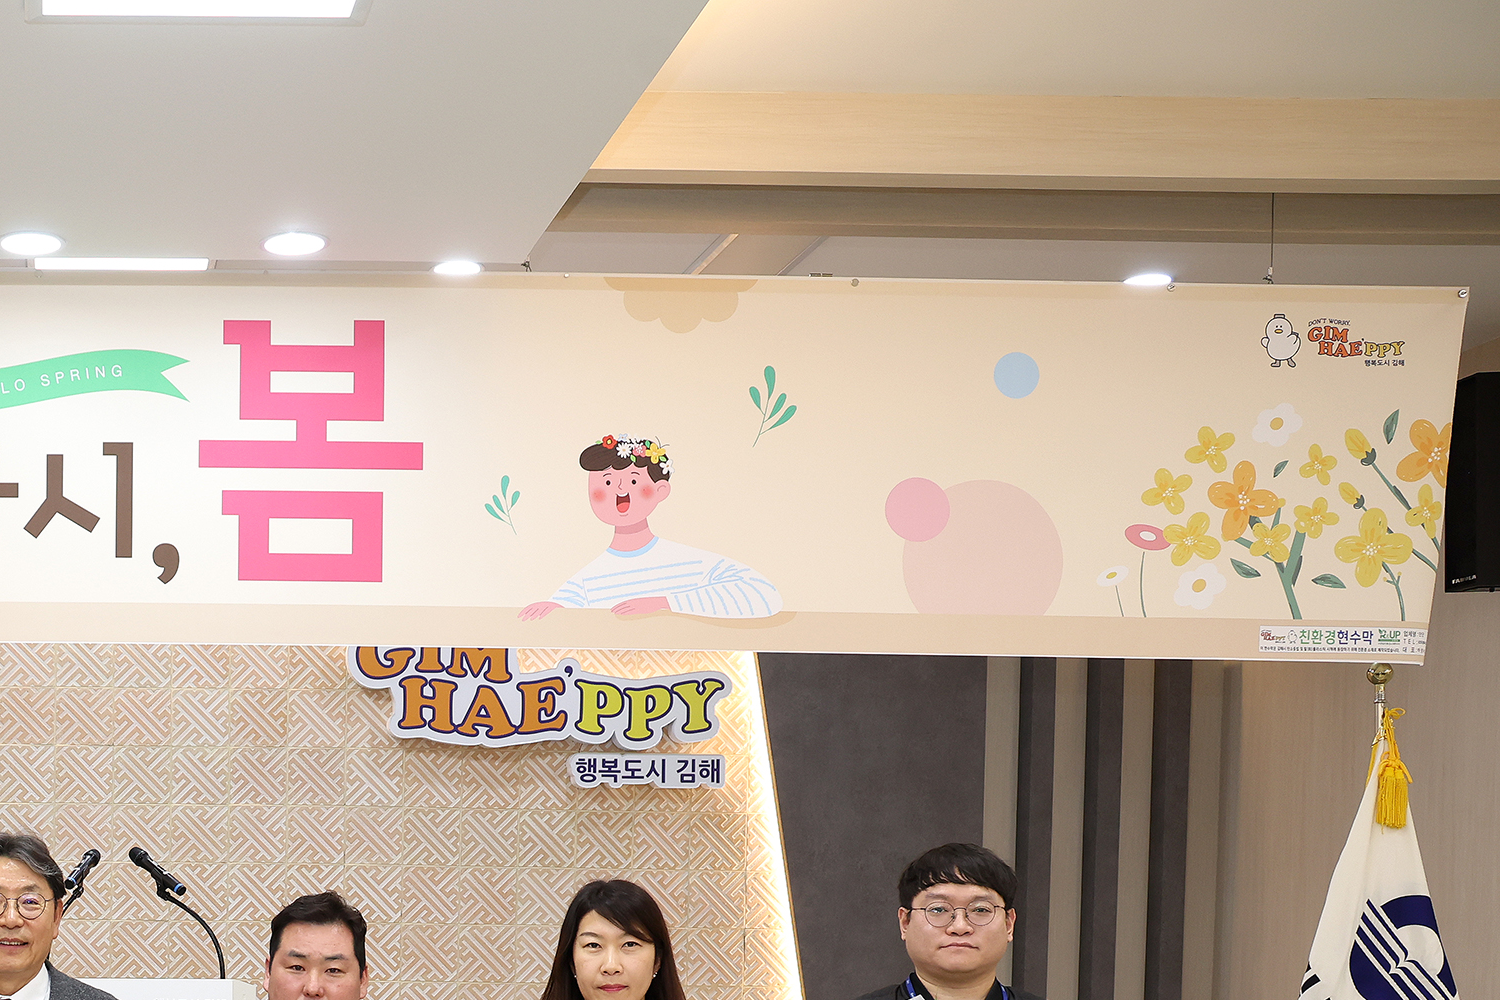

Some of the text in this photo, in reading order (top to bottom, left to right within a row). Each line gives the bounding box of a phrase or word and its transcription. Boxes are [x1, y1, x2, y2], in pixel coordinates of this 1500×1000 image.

[1307, 325, 1349, 343] GIM
[40, 364, 123, 387] SPRING
[199, 320, 424, 583] 봄
[575, 757, 721, 784] 행복도시 김해
